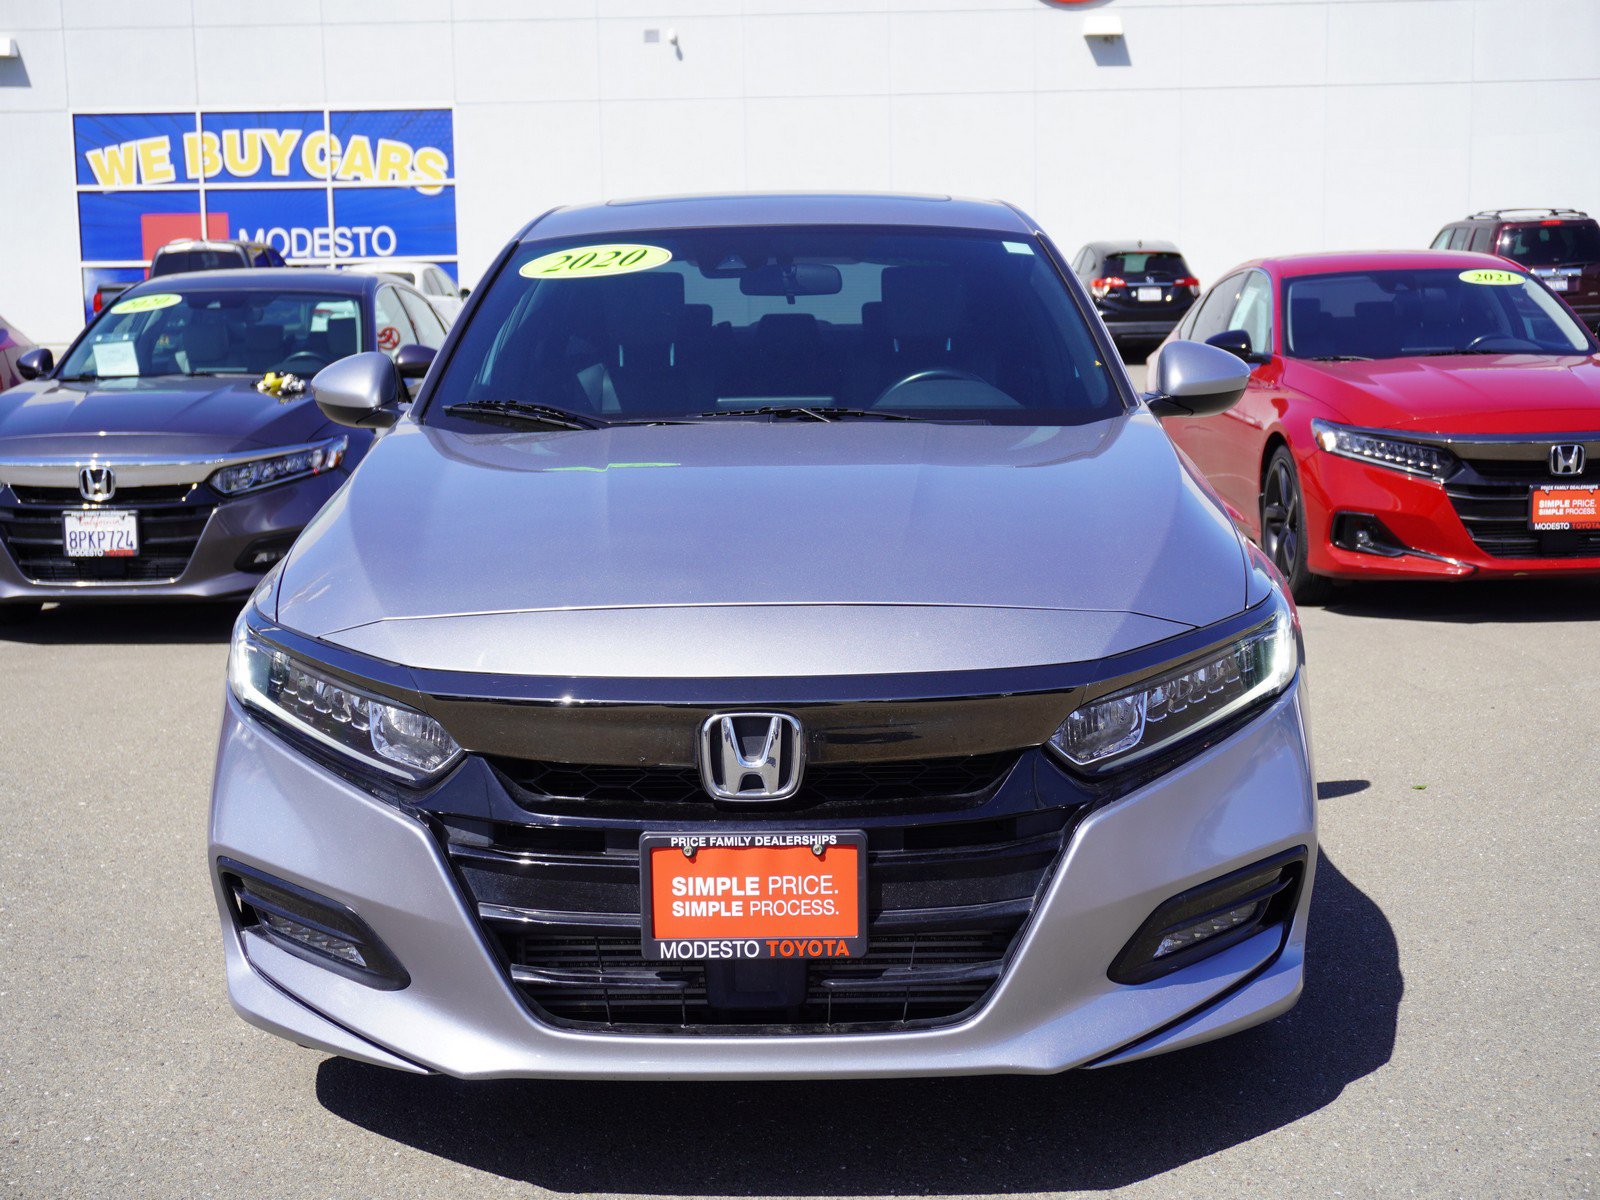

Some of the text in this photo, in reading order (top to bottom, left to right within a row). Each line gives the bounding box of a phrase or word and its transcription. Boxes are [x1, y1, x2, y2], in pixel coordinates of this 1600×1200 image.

[85, 128, 449, 195] WE BUY CARS
[540, 249, 648, 274] 2020
[1473, 273, 1512, 282] 2021
[1538, 499, 1597, 508] SIMPLE PRICE.
[1538, 507, 1597, 516] SIMPLE PROCESS.
[1534, 522, 1570, 530] MODESTO
[69, 530, 133, 549] 8PKP724
[670, 835, 837, 847] PRICE FAMILY DEALERSHIPS
[671, 875, 839, 896] SIMPLE PRICE.
[671, 899, 840, 917] SIMPLE PROCESS.
[660, 939, 850, 959] MODESTO TOYOTA
